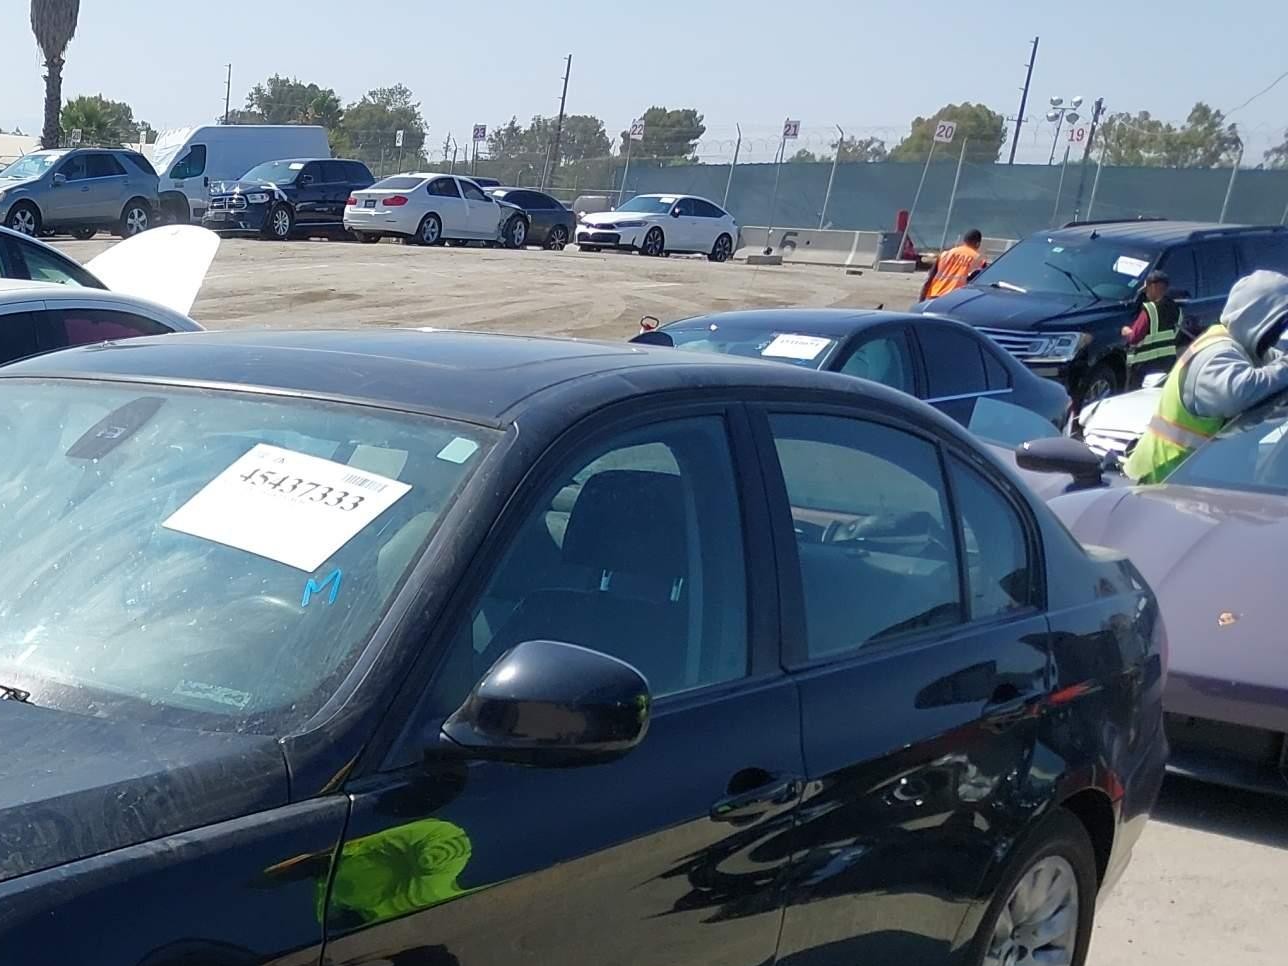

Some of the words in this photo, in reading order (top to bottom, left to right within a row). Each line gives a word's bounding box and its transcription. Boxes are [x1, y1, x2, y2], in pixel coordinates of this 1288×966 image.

[473, 127, 486, 139] 23
[631, 124, 644, 136] 22
[784, 124, 799, 137] 21
[936, 125, 955, 139] 20
[1068, 128, 1085, 142] 19
[240, 468, 365, 512] 45437333
[301, 568, 343, 607] M
